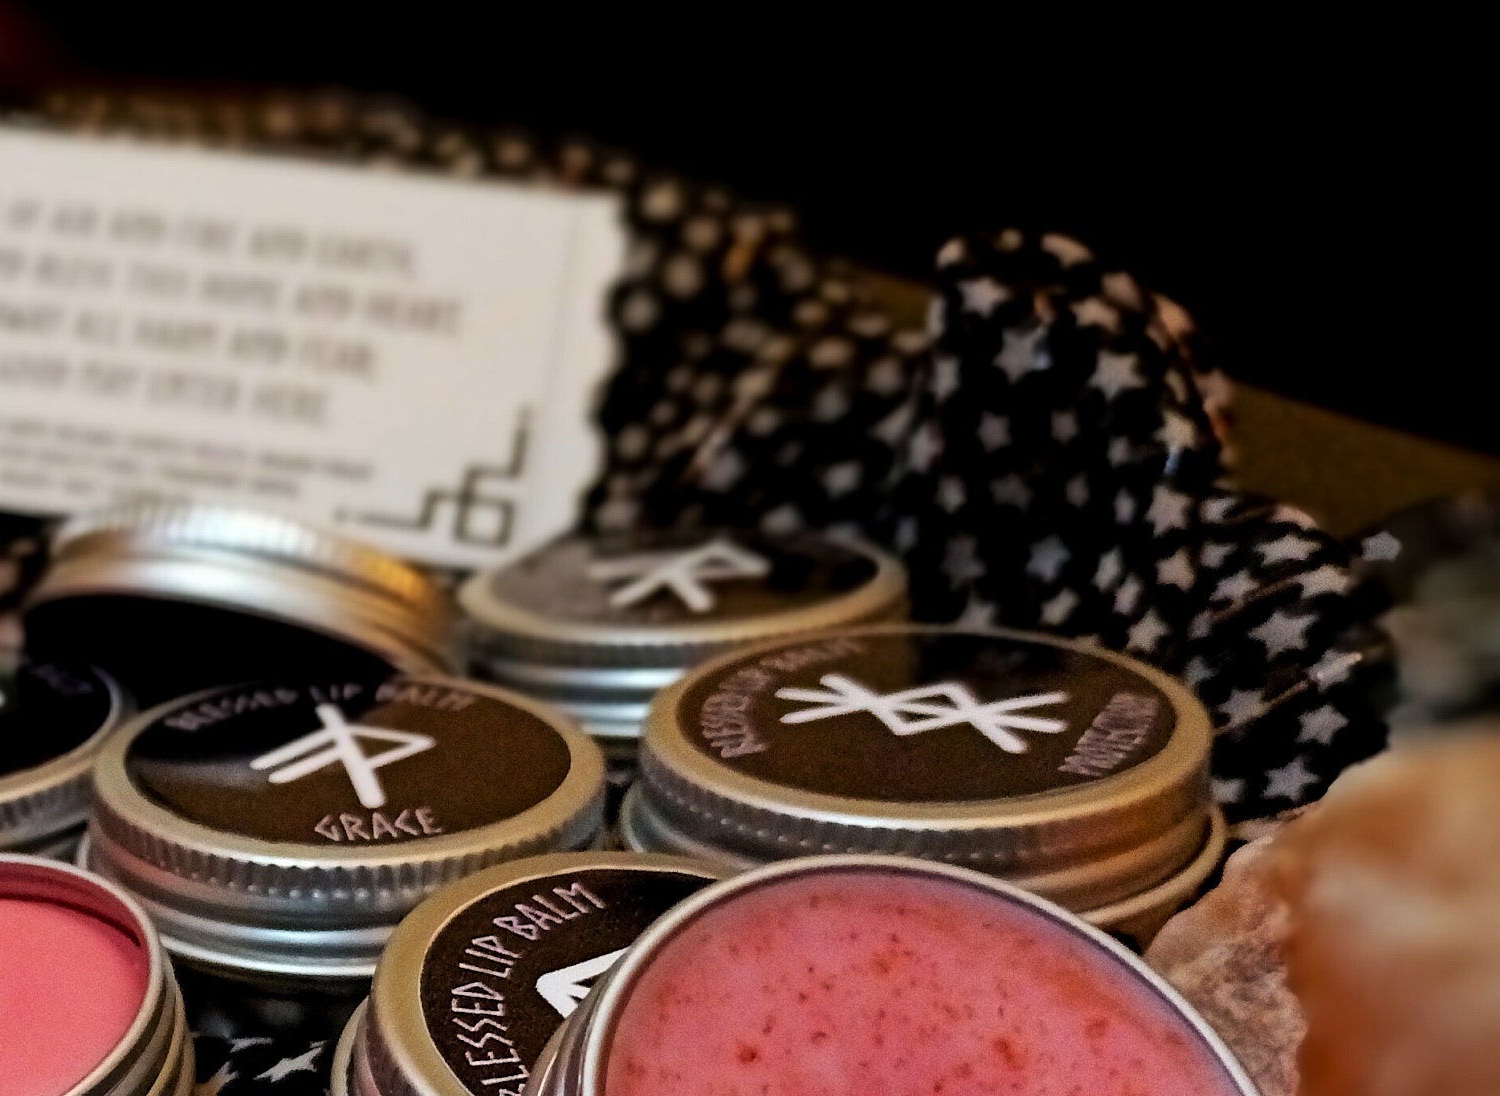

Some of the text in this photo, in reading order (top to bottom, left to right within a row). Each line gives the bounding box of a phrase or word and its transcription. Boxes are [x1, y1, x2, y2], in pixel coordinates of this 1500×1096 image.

[314, 806, 443, 843] GRACE
[459, 935, 522, 979] LIP
[493, 882, 604, 941] BALM
